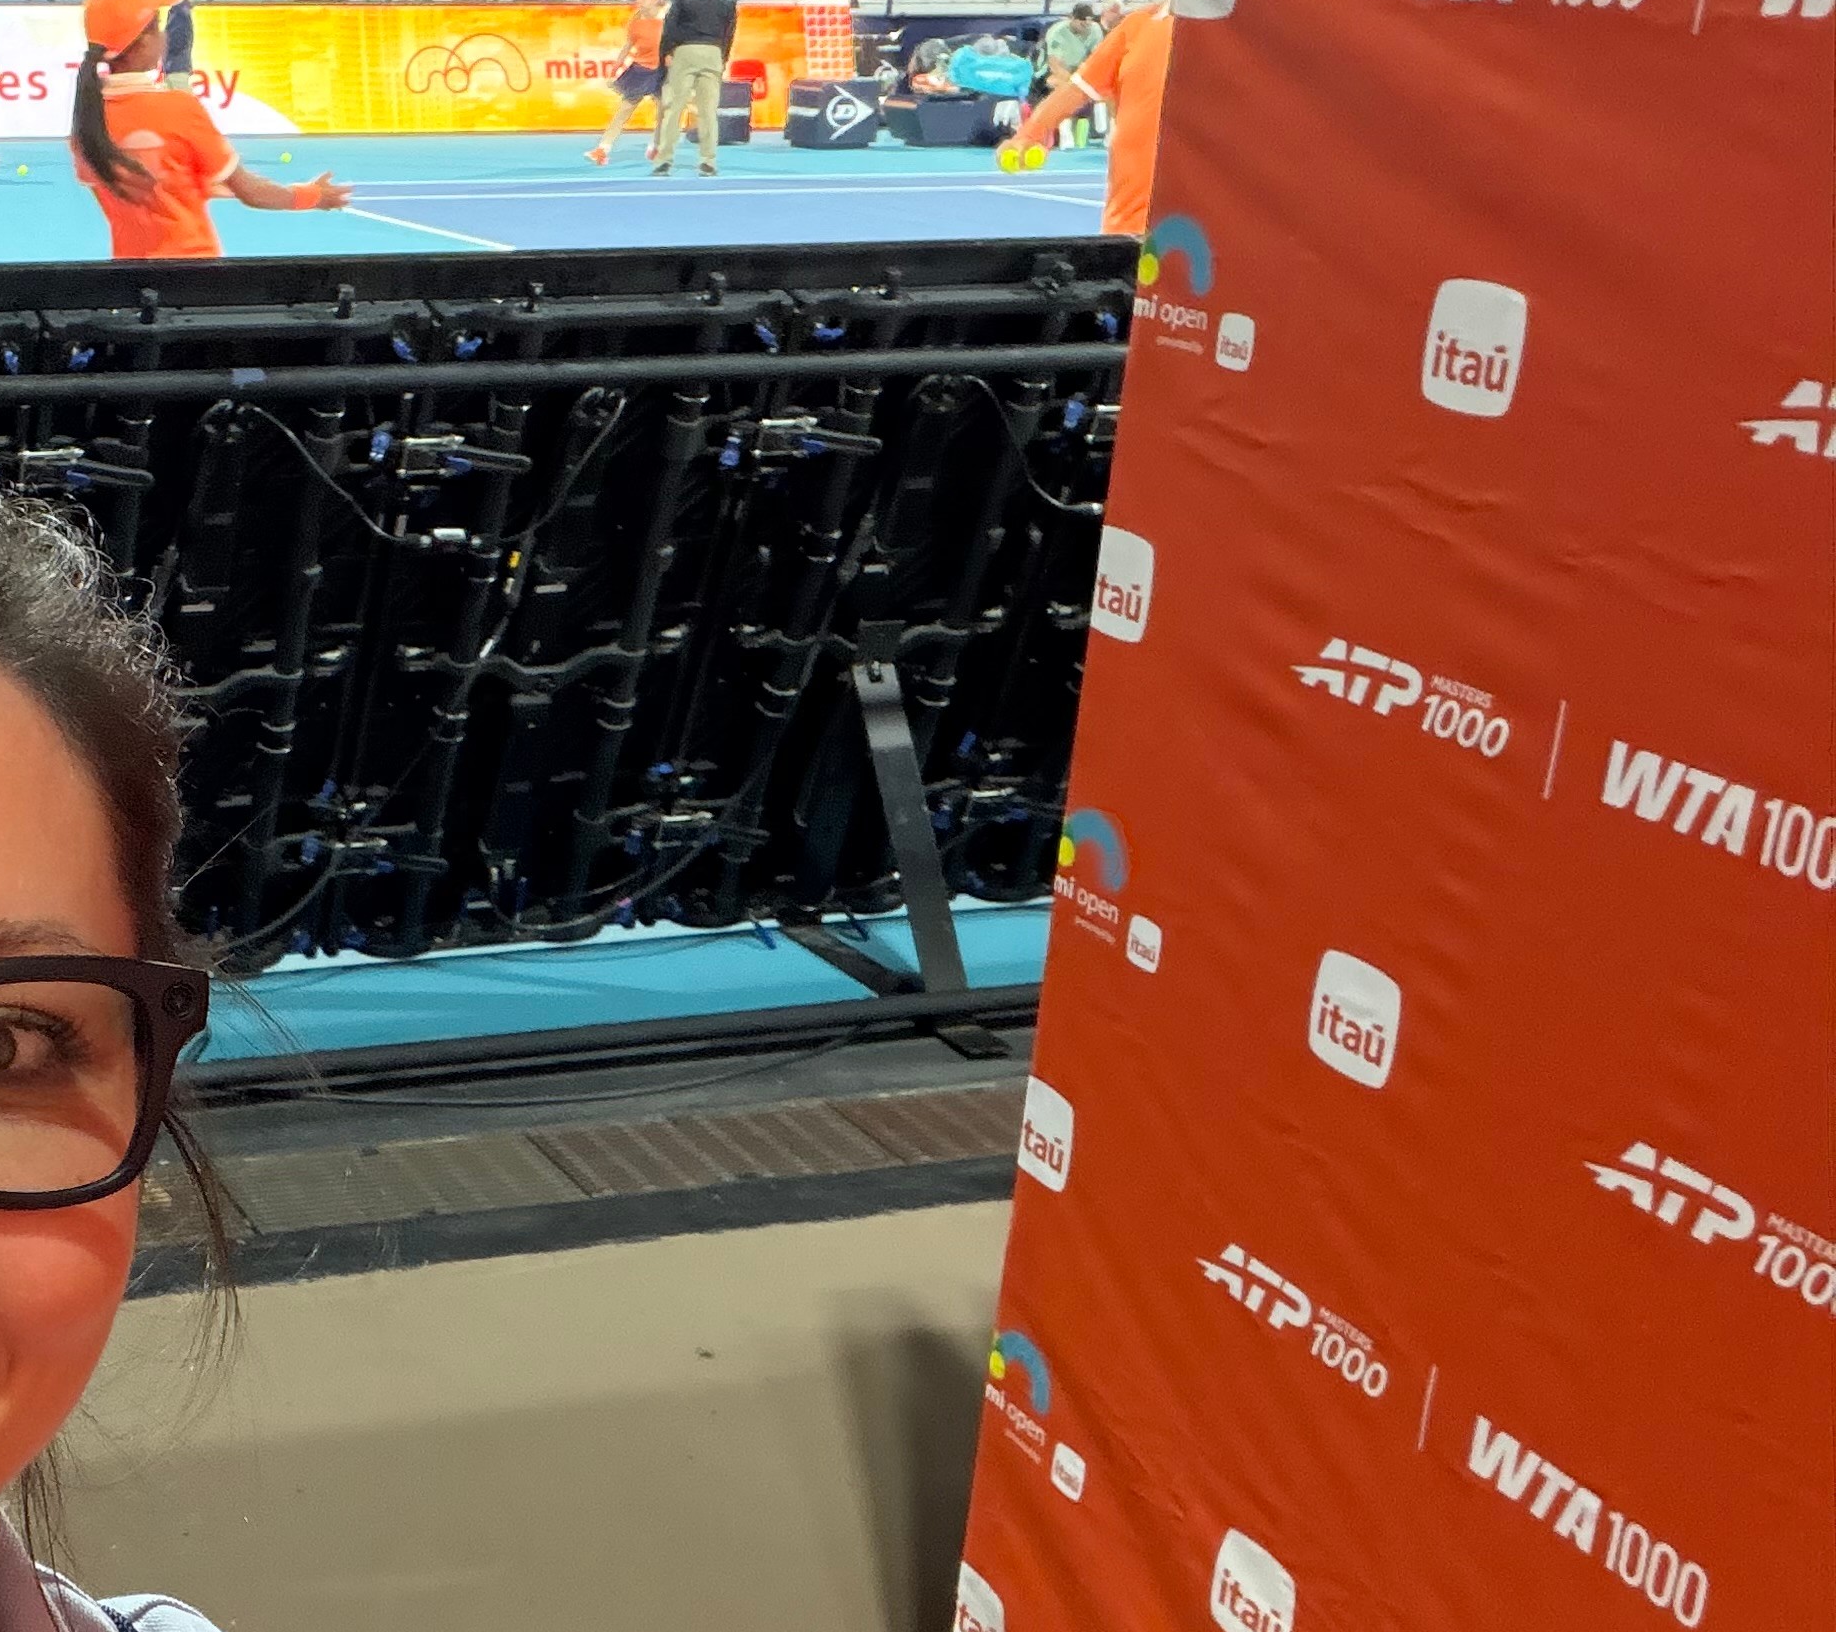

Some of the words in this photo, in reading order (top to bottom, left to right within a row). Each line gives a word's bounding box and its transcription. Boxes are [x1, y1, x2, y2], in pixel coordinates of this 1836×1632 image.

[1159, 302, 1208, 331] open
[1430, 331, 1510, 394] itaú
[1097, 573, 1143, 624] taú
[1290, 636, 1424, 716] ATP
[1421, 693, 1511, 759] 1000
[1600, 738, 1757, 857] WTA
[1759, 797, 1836, 891] 100
[1076, 887, 1119, 925] open
[1316, 994, 1387, 1068] itaú
[1024, 1118, 1064, 1174] taú
[1582, 1140, 1756, 1245] ATP
[1753, 1234, 1836, 1316] 100
[1005, 1401, 1047, 1447] open
[1195, 1242, 1312, 1330] ATP
[1309, 1322, 1389, 1398] 1000
[1468, 1414, 1603, 1555] WTA
[1604, 1510, 1709, 1630] 1000
